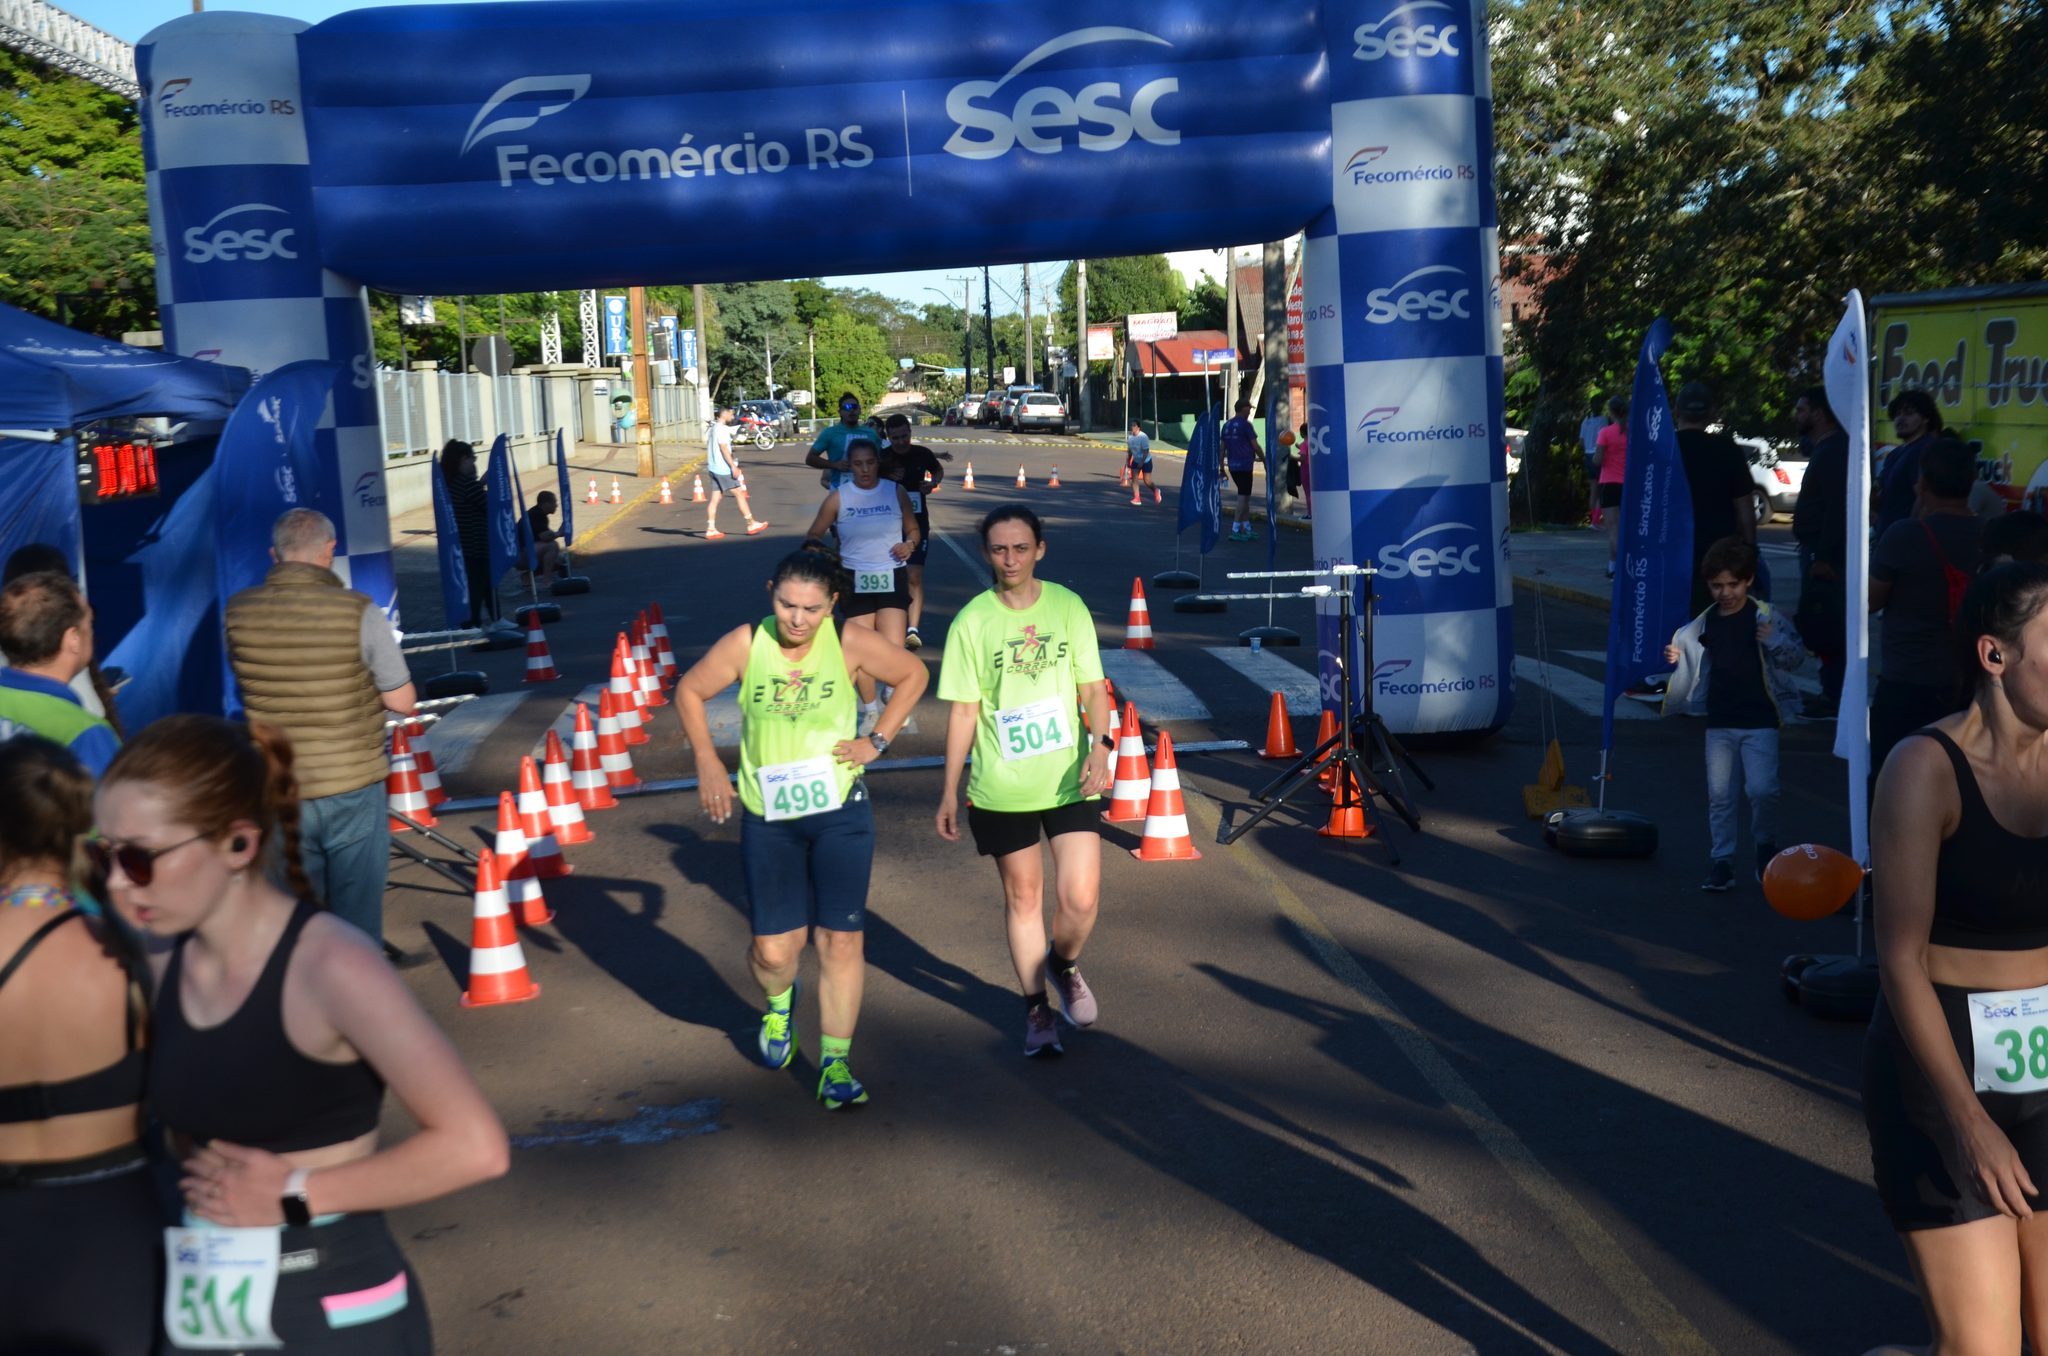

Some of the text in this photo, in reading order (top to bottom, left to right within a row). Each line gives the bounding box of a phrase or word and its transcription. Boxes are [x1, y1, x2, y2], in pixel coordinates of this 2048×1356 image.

[1352, 23, 1459, 60] Sesc
[165, 99, 295, 118] Fecomércio RS
[943, 77, 1181, 160] Sesc
[496, 125, 874, 187] Fecomércio RS
[1354, 165, 1476, 185] Fecomércio RS
[184, 226, 298, 263] Sesc
[1364, 287, 1470, 324] Sesc
[610, 315, 622, 353] URI
[1880, 321, 1967, 408] Food
[1367, 423, 1486, 443] Fecomércio RS
[1638, 464, 1654, 537] Sindicatos
[1376, 543, 1481, 579] Sesc
[1635, 558, 1648, 577] RS
[860, 574, 890, 591] 393
[1632, 581, 1647, 663] Fecomércio
[1006, 660, 1058, 674] CORREM
[1379, 678, 1475, 695] Fecomércio
[1479, 674, 1496, 690] RS
[765, 702, 821, 713] CORREM
[1008, 717, 1062, 754] 504
[774, 779, 830, 814] 498
[1994, 1025, 2048, 1083] 38
[178, 1274, 256, 1337] 511
